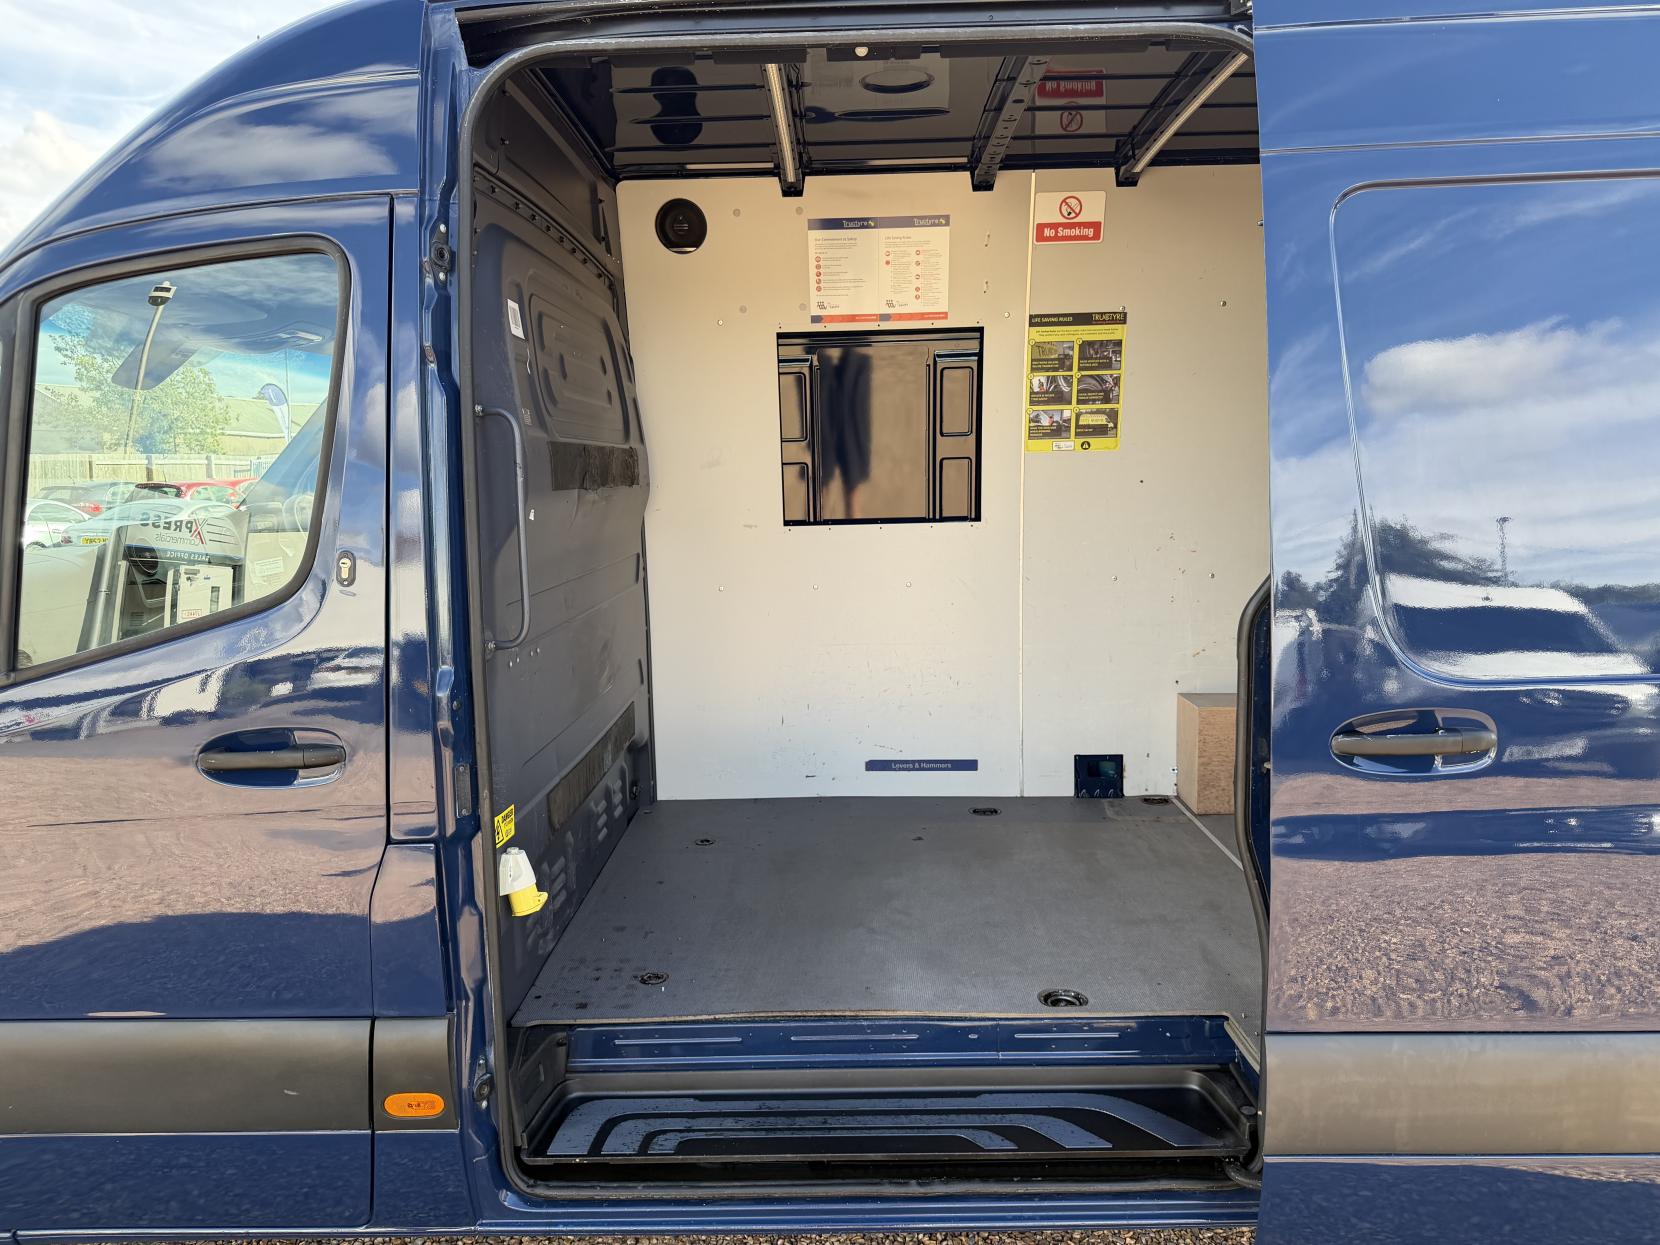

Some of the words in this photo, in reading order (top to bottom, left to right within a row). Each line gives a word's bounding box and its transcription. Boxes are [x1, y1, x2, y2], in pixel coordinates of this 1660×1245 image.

[1043, 227, 1055, 237] No
[1057, 226, 1094, 238] Smoking
[920, 761, 952, 769] Hammers
